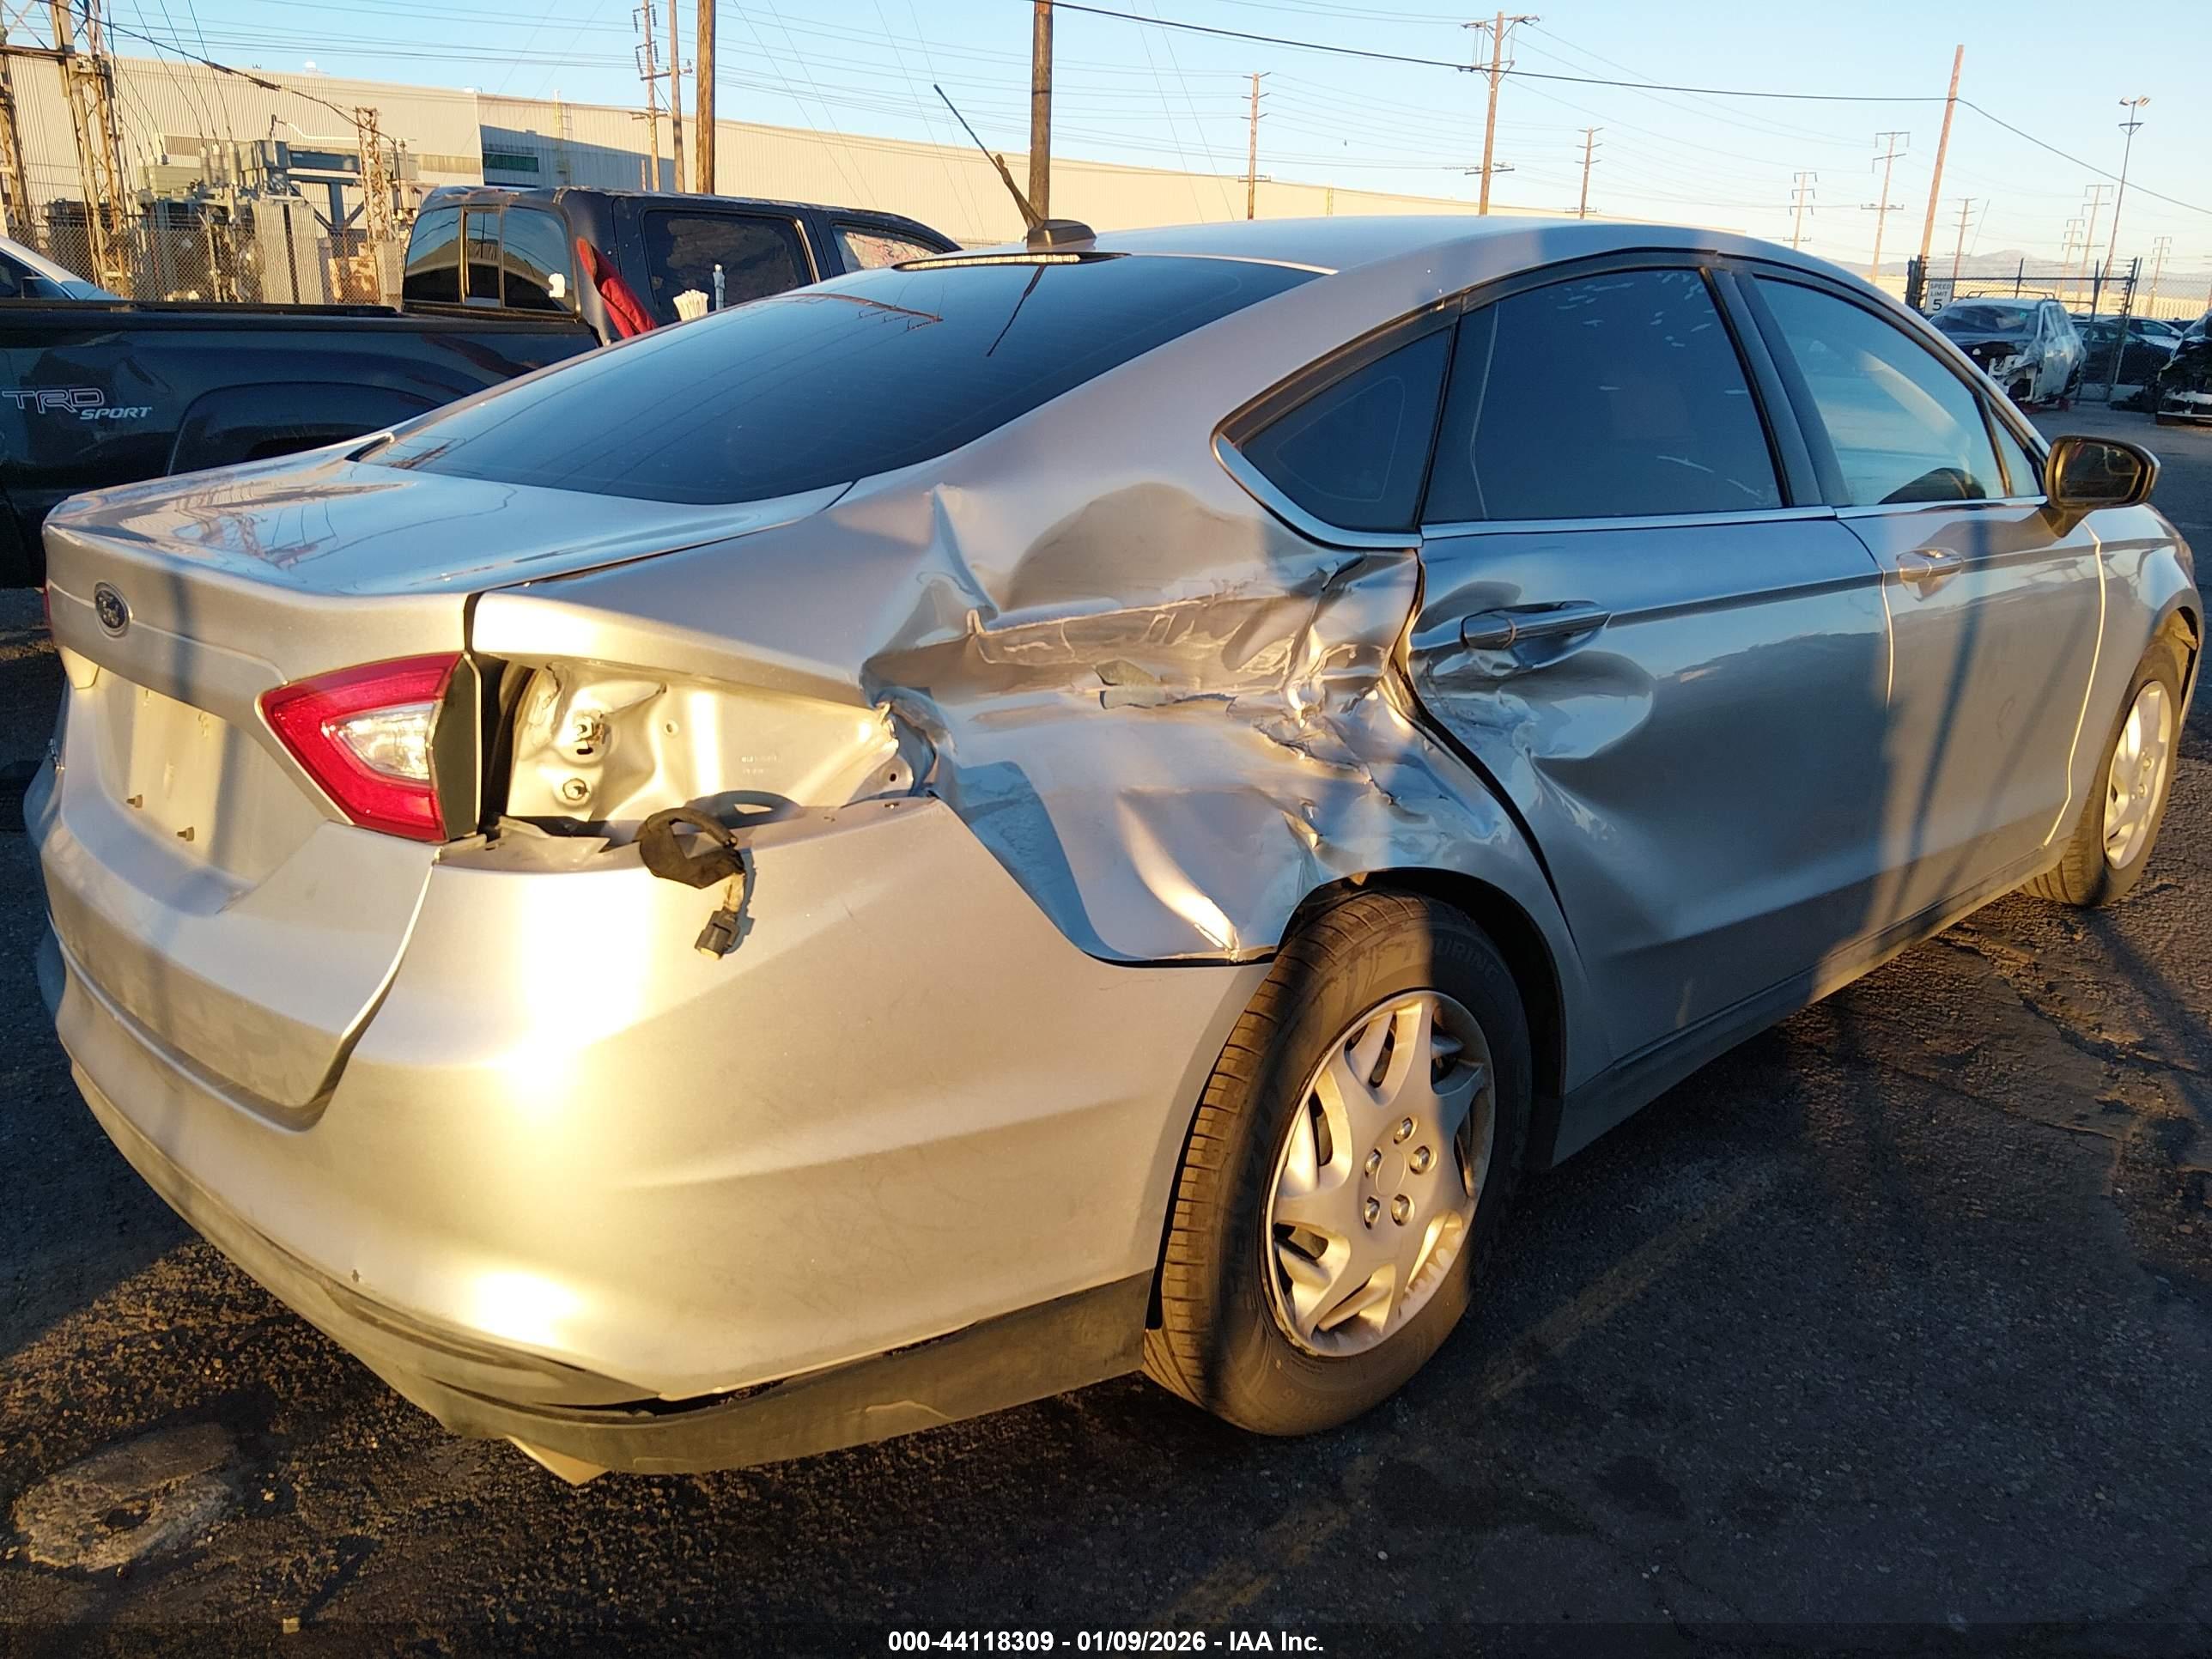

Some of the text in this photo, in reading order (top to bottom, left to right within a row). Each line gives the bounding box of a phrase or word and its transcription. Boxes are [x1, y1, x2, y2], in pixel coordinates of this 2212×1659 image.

[1932, 298, 1942, 311] 5
[2, 387, 105, 414] TRD
[79, 405, 153, 420] SPORT
